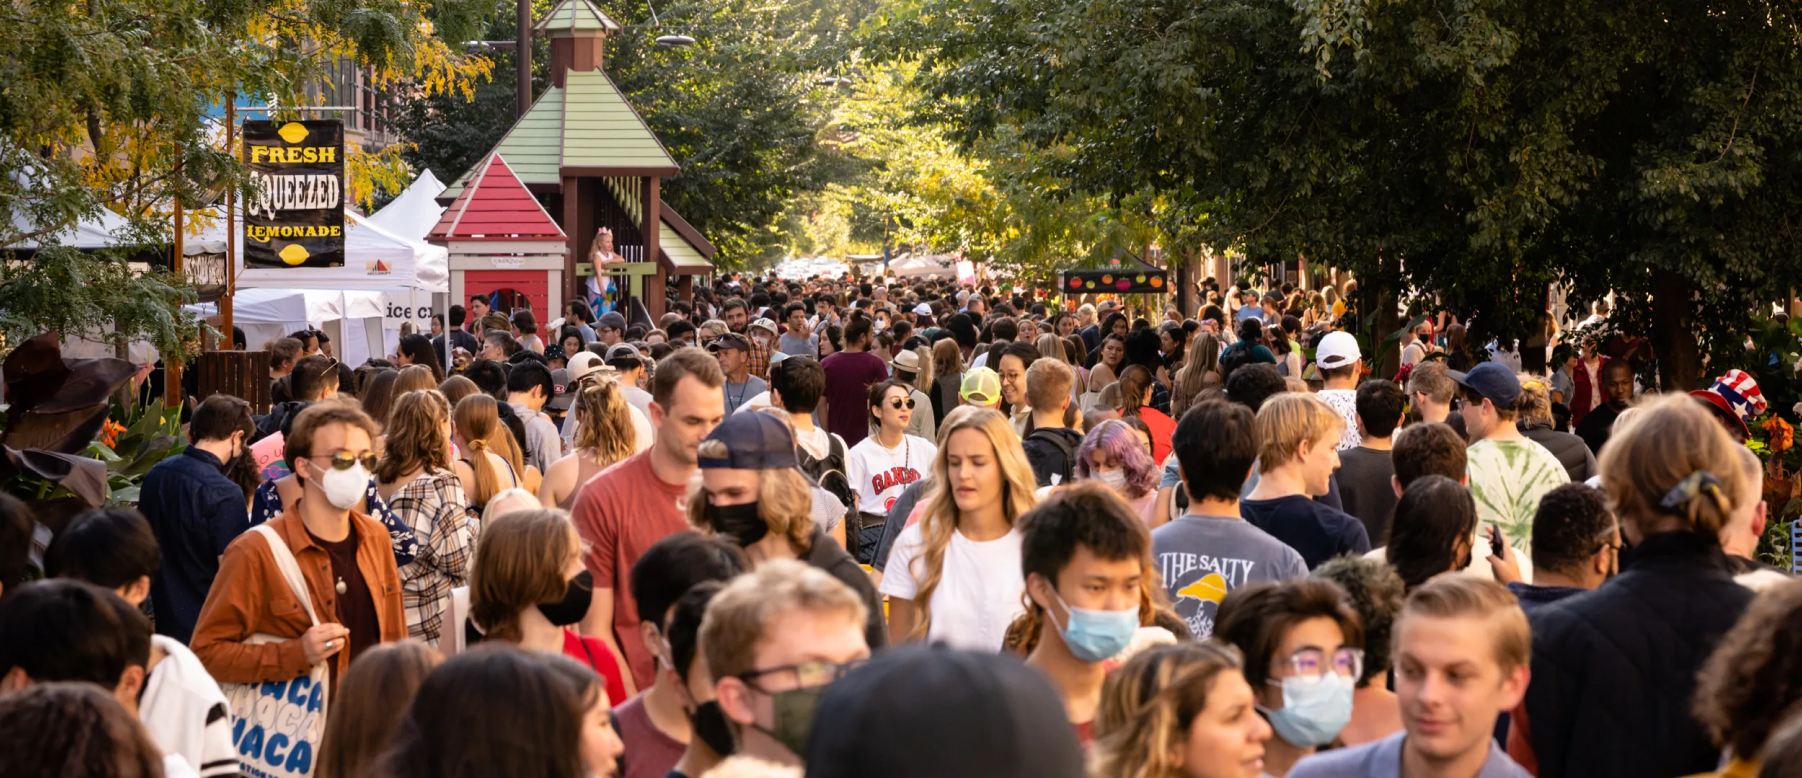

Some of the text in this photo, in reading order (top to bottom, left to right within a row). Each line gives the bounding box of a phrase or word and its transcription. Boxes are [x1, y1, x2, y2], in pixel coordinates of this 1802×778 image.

[251, 145, 336, 163] FRESH
[248, 170, 340, 221] SQUEEZED
[247, 225, 341, 243] LEMONADE
[386, 302, 412, 319] ice
[1159, 552, 1256, 590] THE SALTY
